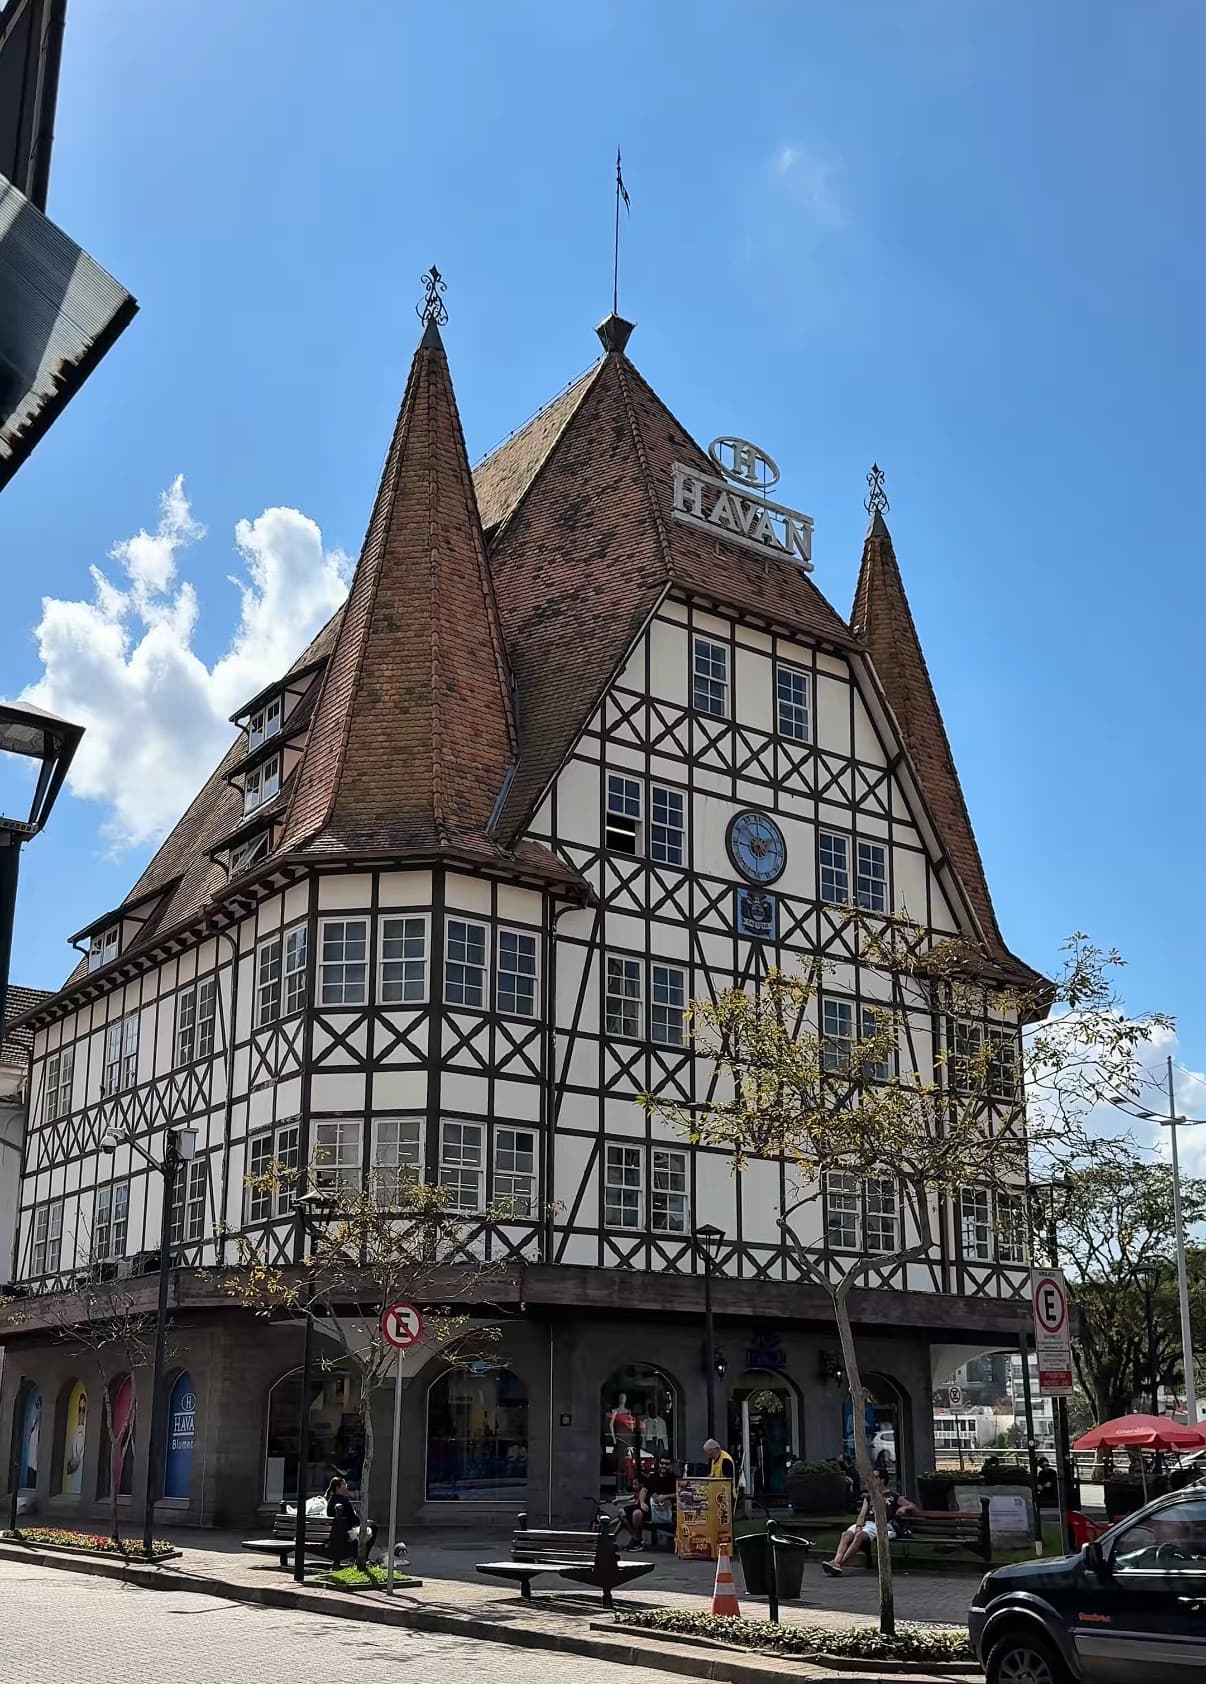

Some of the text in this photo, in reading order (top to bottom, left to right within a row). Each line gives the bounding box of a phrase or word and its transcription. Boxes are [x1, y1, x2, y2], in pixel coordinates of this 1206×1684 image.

[731, 441, 758, 481] H
[671, 469, 815, 562] HAVAN
[1044, 1290, 1057, 1322] E
[395, 1312, 411, 1338] E
[173, 1415, 195, 1432] HAVA
